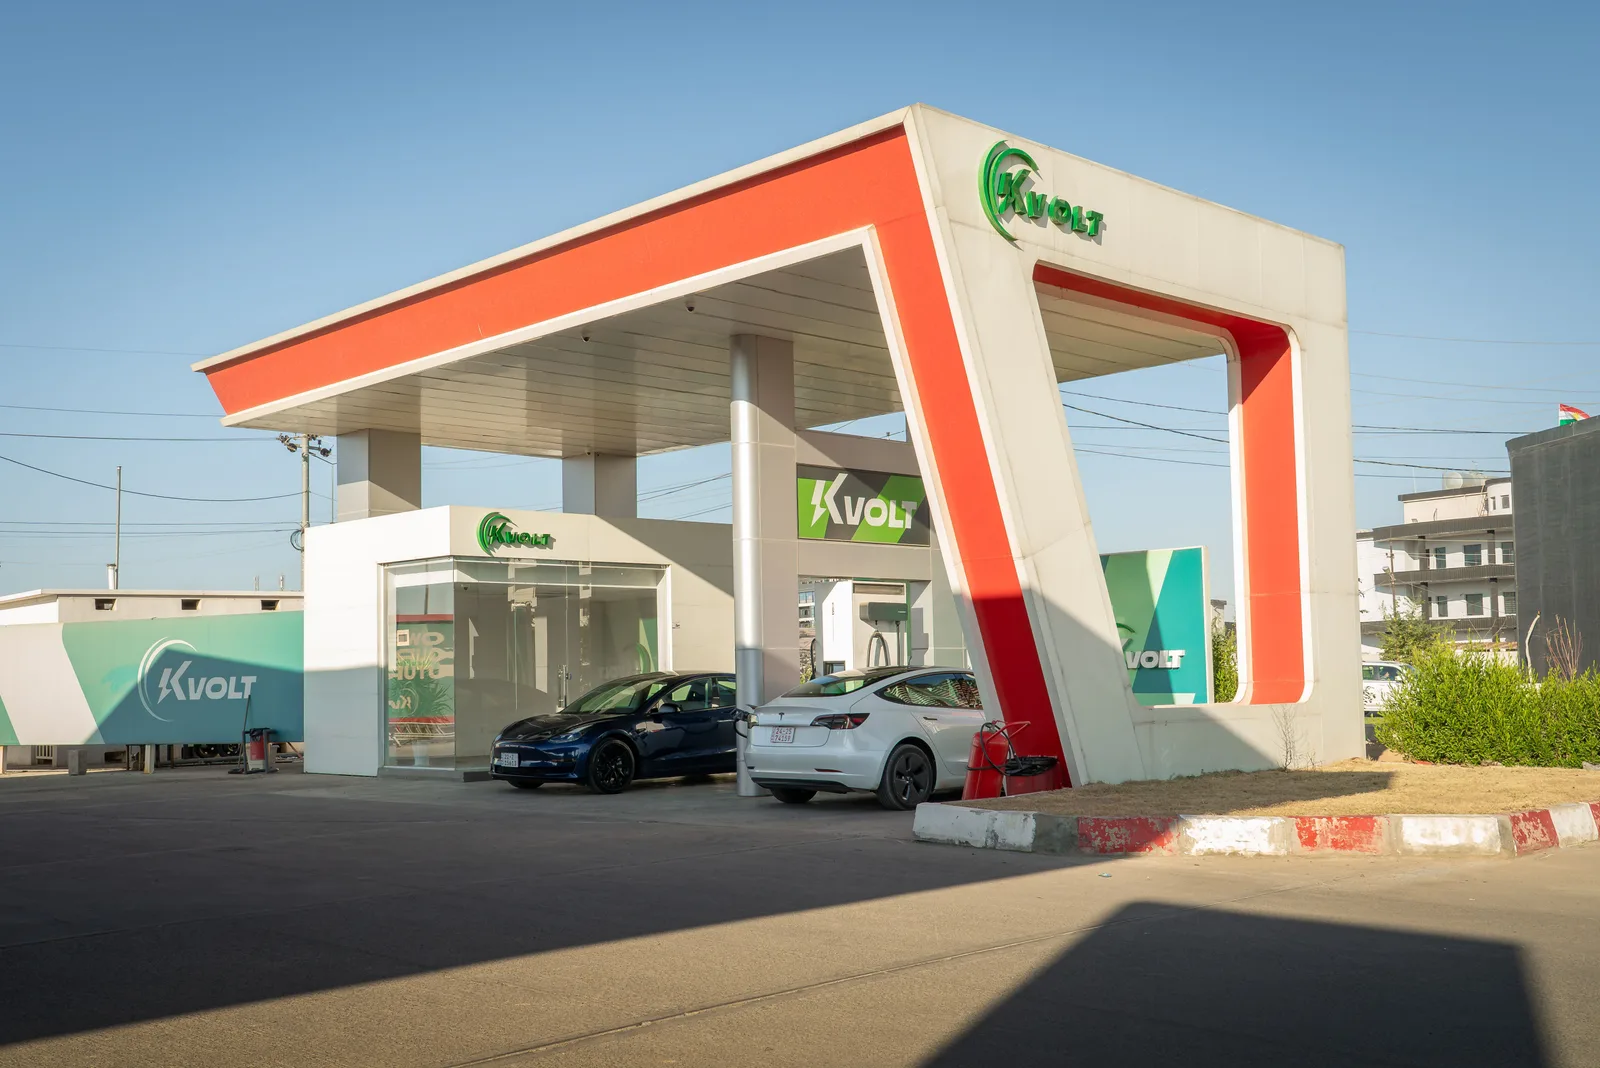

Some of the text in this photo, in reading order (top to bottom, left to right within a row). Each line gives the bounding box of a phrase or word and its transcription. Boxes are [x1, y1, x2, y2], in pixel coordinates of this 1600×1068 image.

[997, 168, 1104, 237] KVOLT
[810, 472, 918, 529] KVOLT
[488, 522, 551, 546] KVOLT
[157, 660, 258, 705] KVOLT
